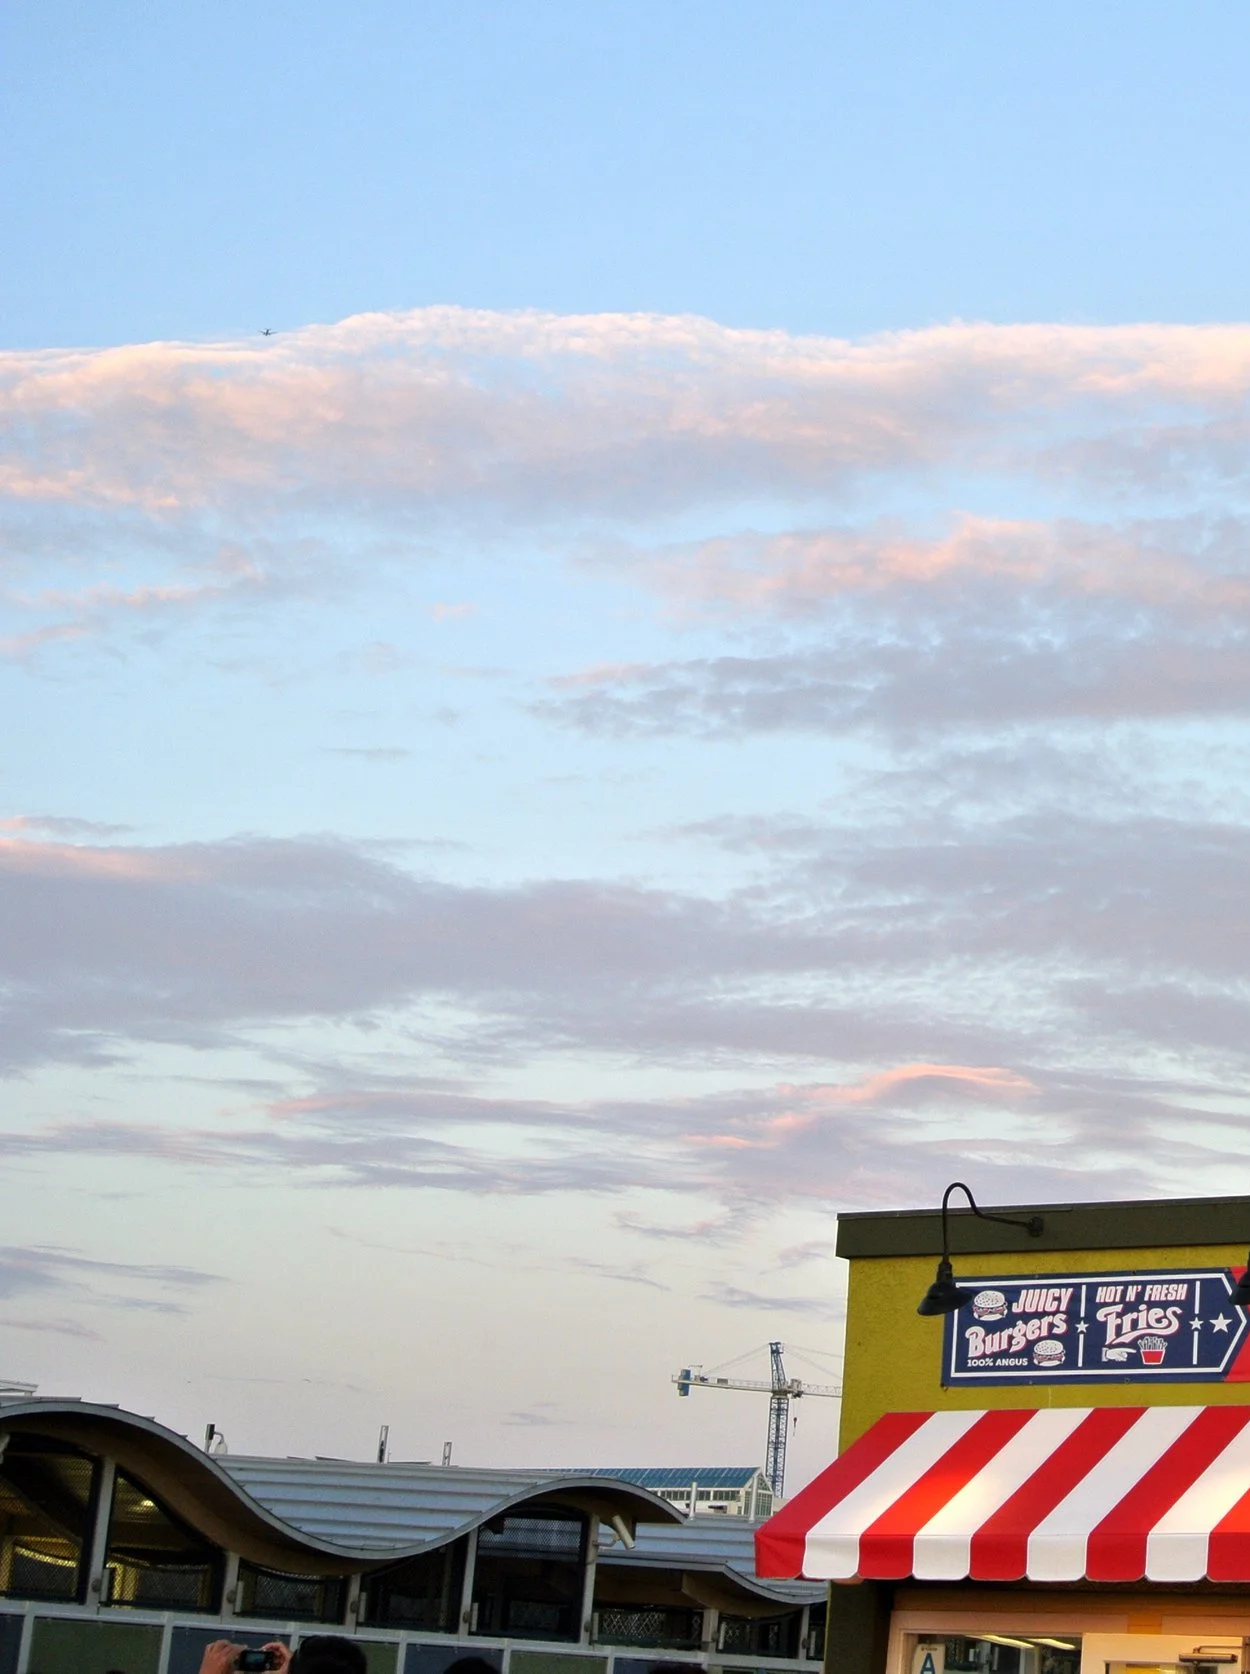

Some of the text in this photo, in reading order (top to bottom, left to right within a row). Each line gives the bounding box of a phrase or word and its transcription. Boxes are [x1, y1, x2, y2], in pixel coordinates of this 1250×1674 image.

[1012, 1288, 1073, 1314] JUICY
[1095, 1286, 1123, 1303] HOT
[1144, 1284, 1187, 1301] FRESH
[965, 1313, 1067, 1357] Burgers
[1096, 1305, 1183, 1345] Fries
[967, 1357, 1028, 1367] 100% ANGUS
[920, 1652, 936, 1674] A
